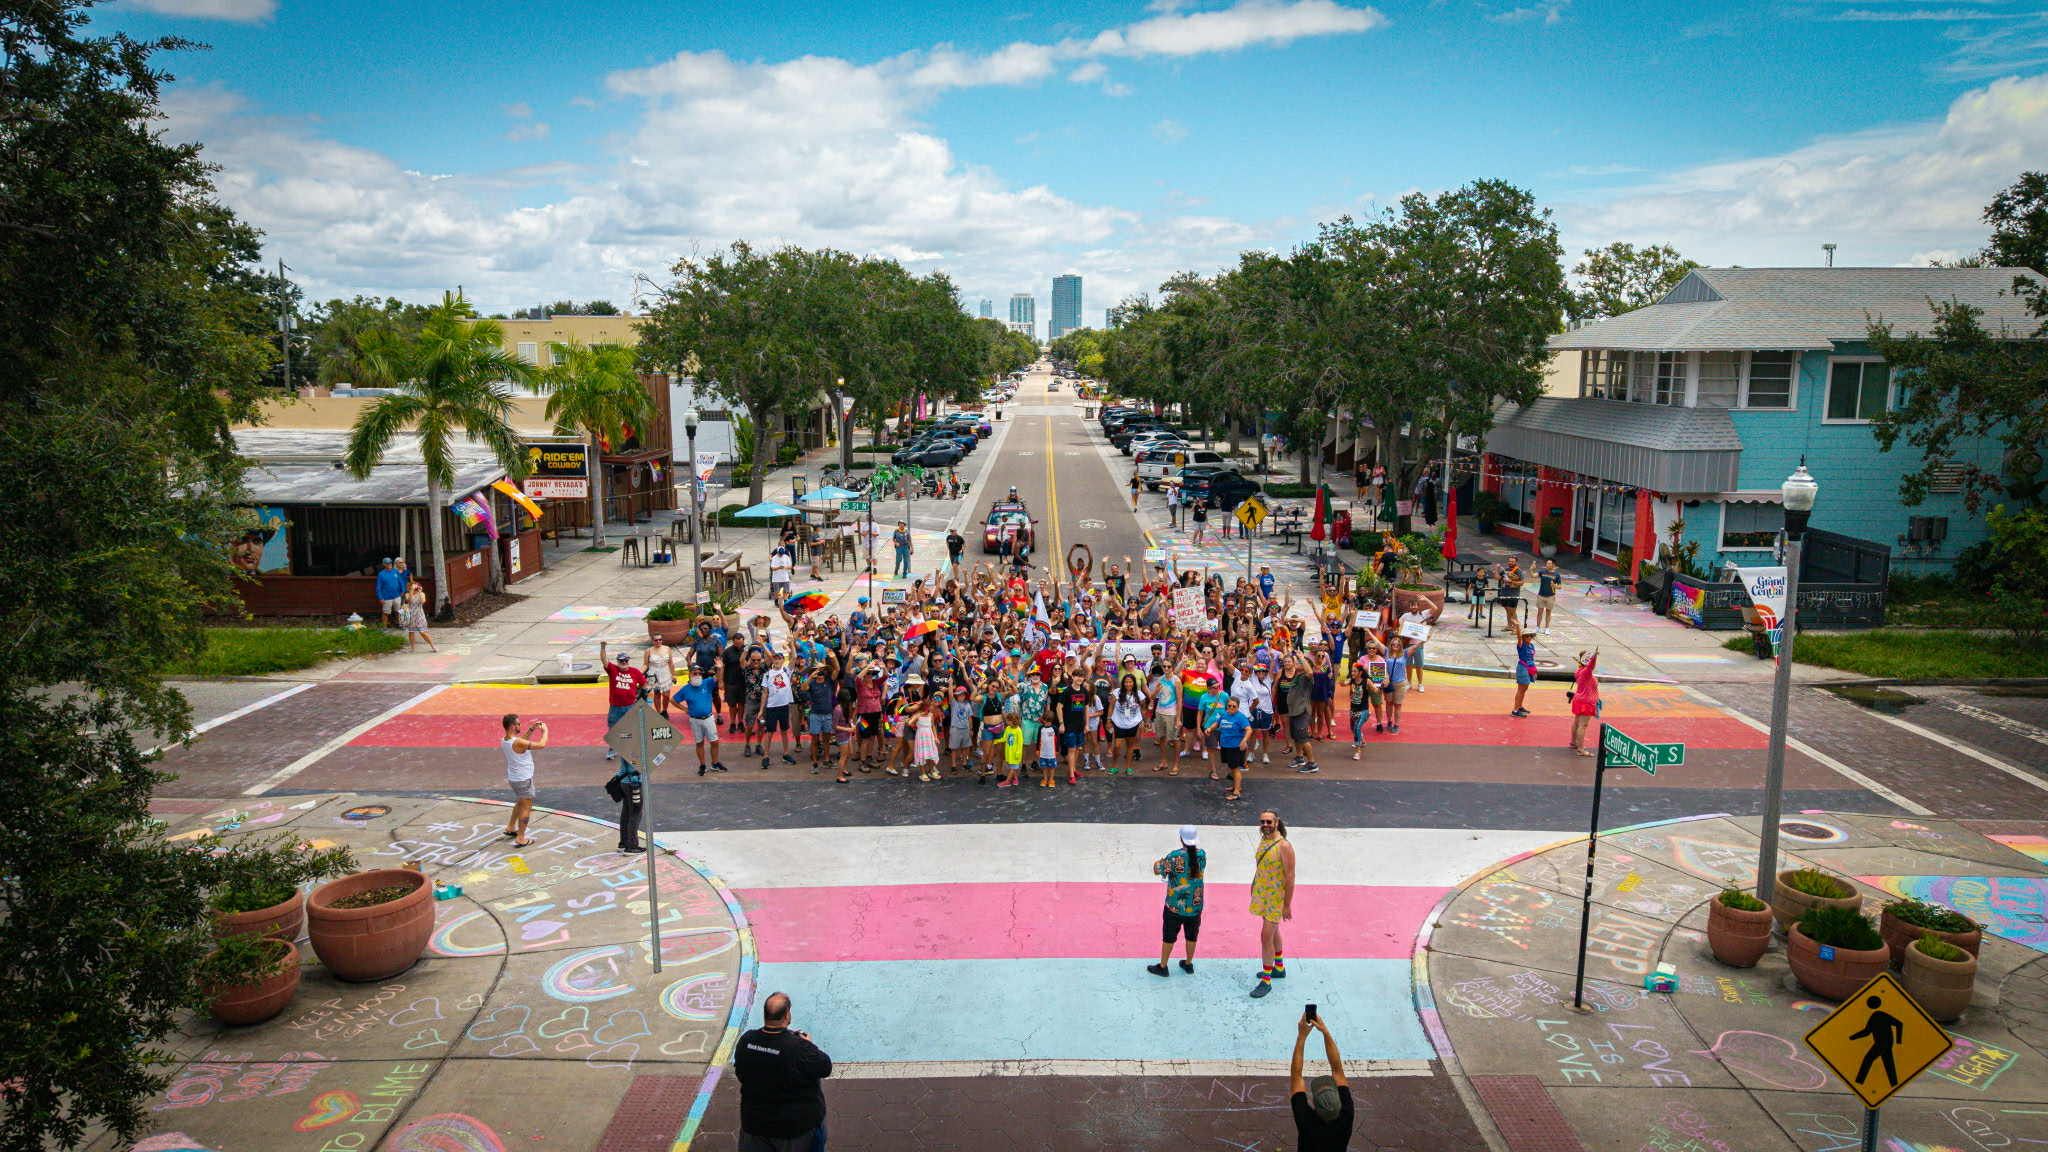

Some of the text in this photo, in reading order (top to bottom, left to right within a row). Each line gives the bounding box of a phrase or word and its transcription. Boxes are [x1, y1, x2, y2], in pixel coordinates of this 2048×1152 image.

[547, 461, 581, 469] COWBOY
[1751, 586, 1785, 599] Central
[1756, 575, 1786, 588] Grand
[1606, 728, 1656, 772] Central Ave S
[1668, 746, 1680, 763] S
[374, 840, 527, 871] STRONG
[1585, 912, 1665, 976] KEEP
[1535, 1019, 1602, 1086] LOVE
[1605, 1022, 1693, 1088] LOVE
[350, 1063, 429, 1122] BLAME
